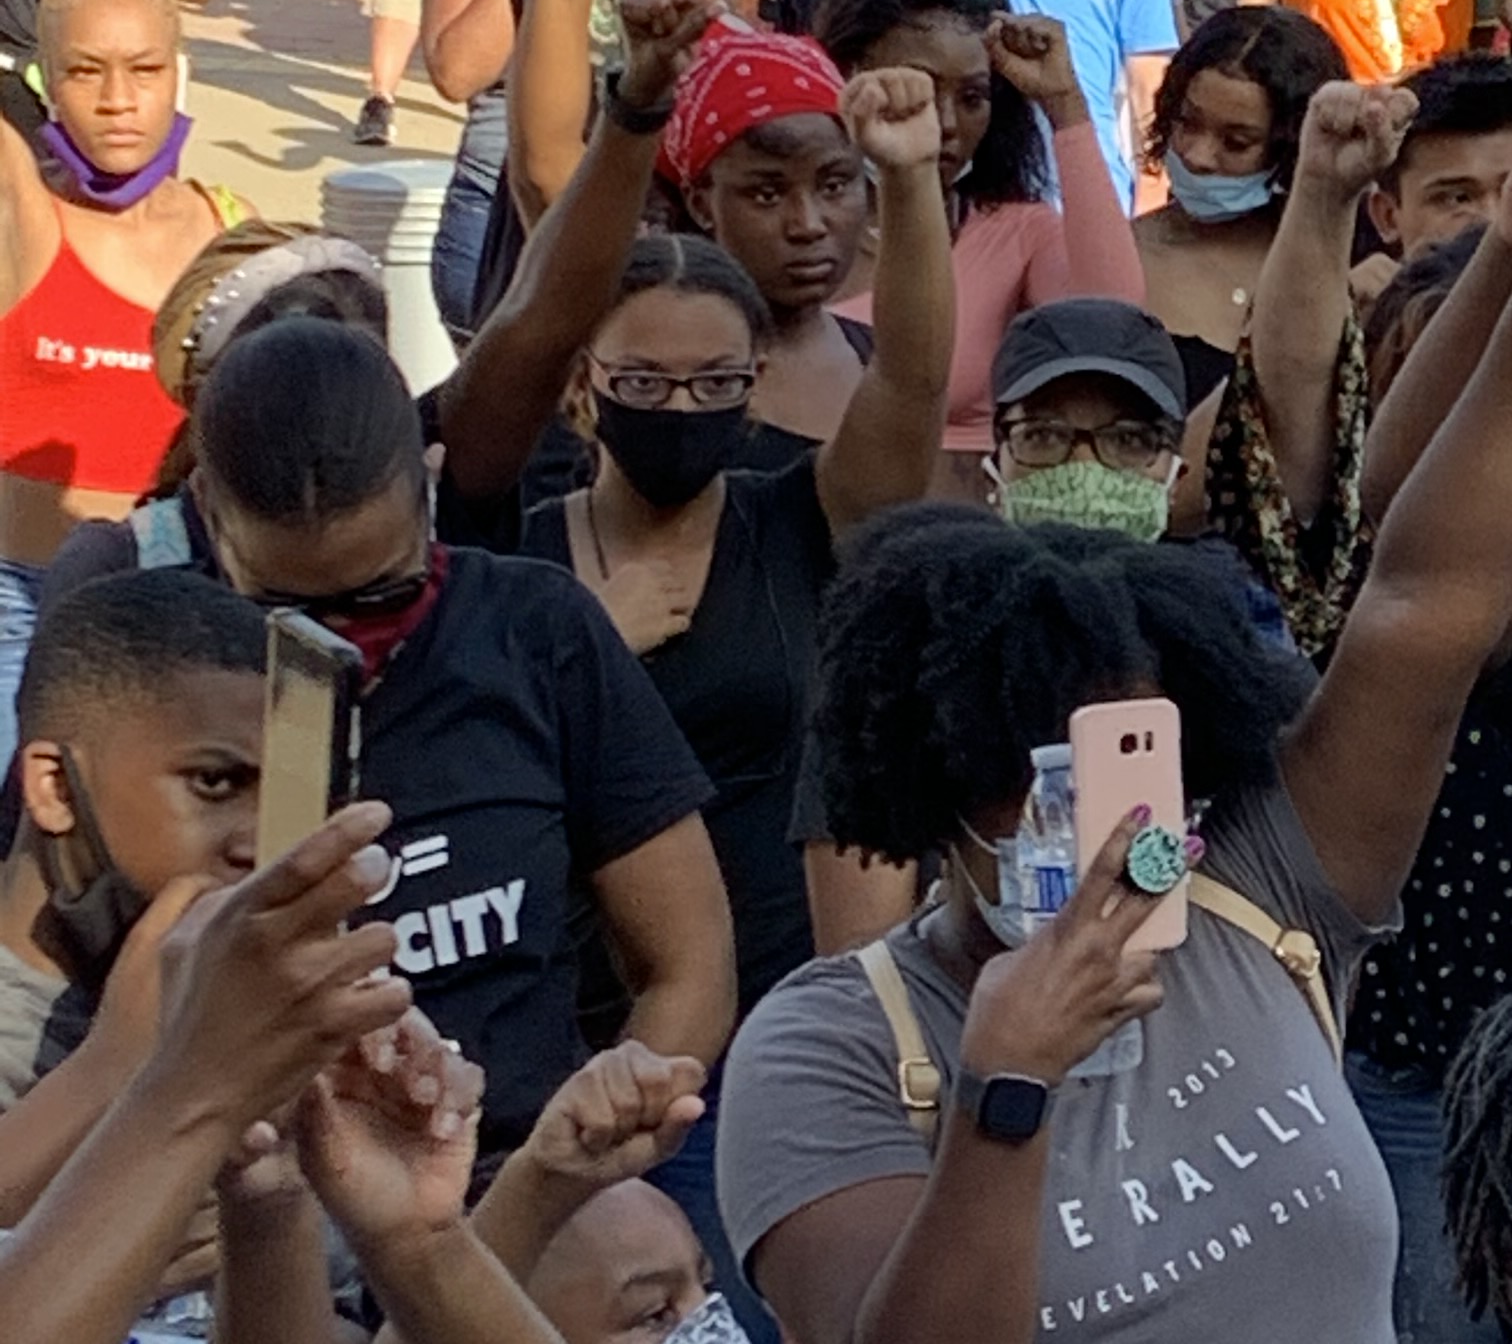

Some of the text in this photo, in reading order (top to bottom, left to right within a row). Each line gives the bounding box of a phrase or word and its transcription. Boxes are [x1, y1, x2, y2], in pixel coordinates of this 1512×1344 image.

[36, 335, 76, 364] It's
[368, 878, 526, 982] CITY
[1167, 1048, 1236, 1108] 2013
